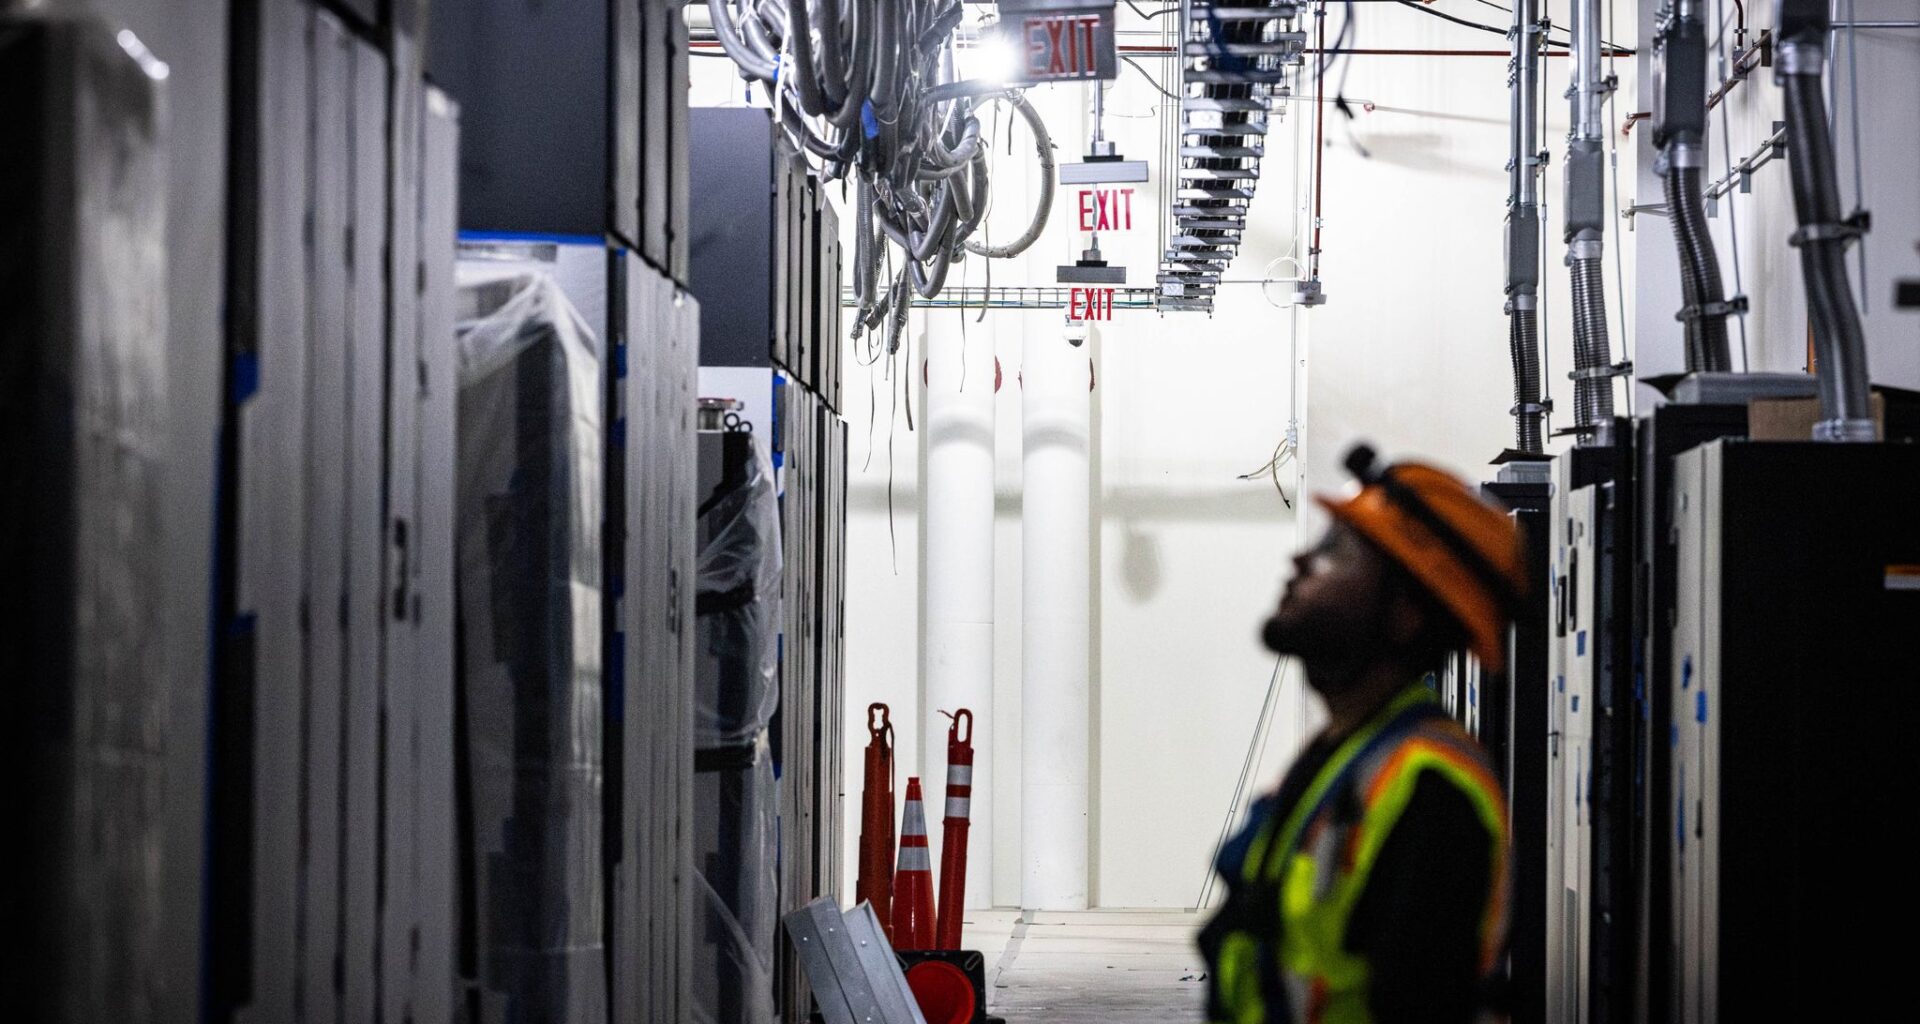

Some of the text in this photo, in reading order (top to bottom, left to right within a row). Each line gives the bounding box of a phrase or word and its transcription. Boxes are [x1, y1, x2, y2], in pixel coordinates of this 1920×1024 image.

[1024, 15, 1100, 76] EXIT
[1079, 190, 1134, 231] EXIT
[1070, 288, 1115, 321] EXIT
